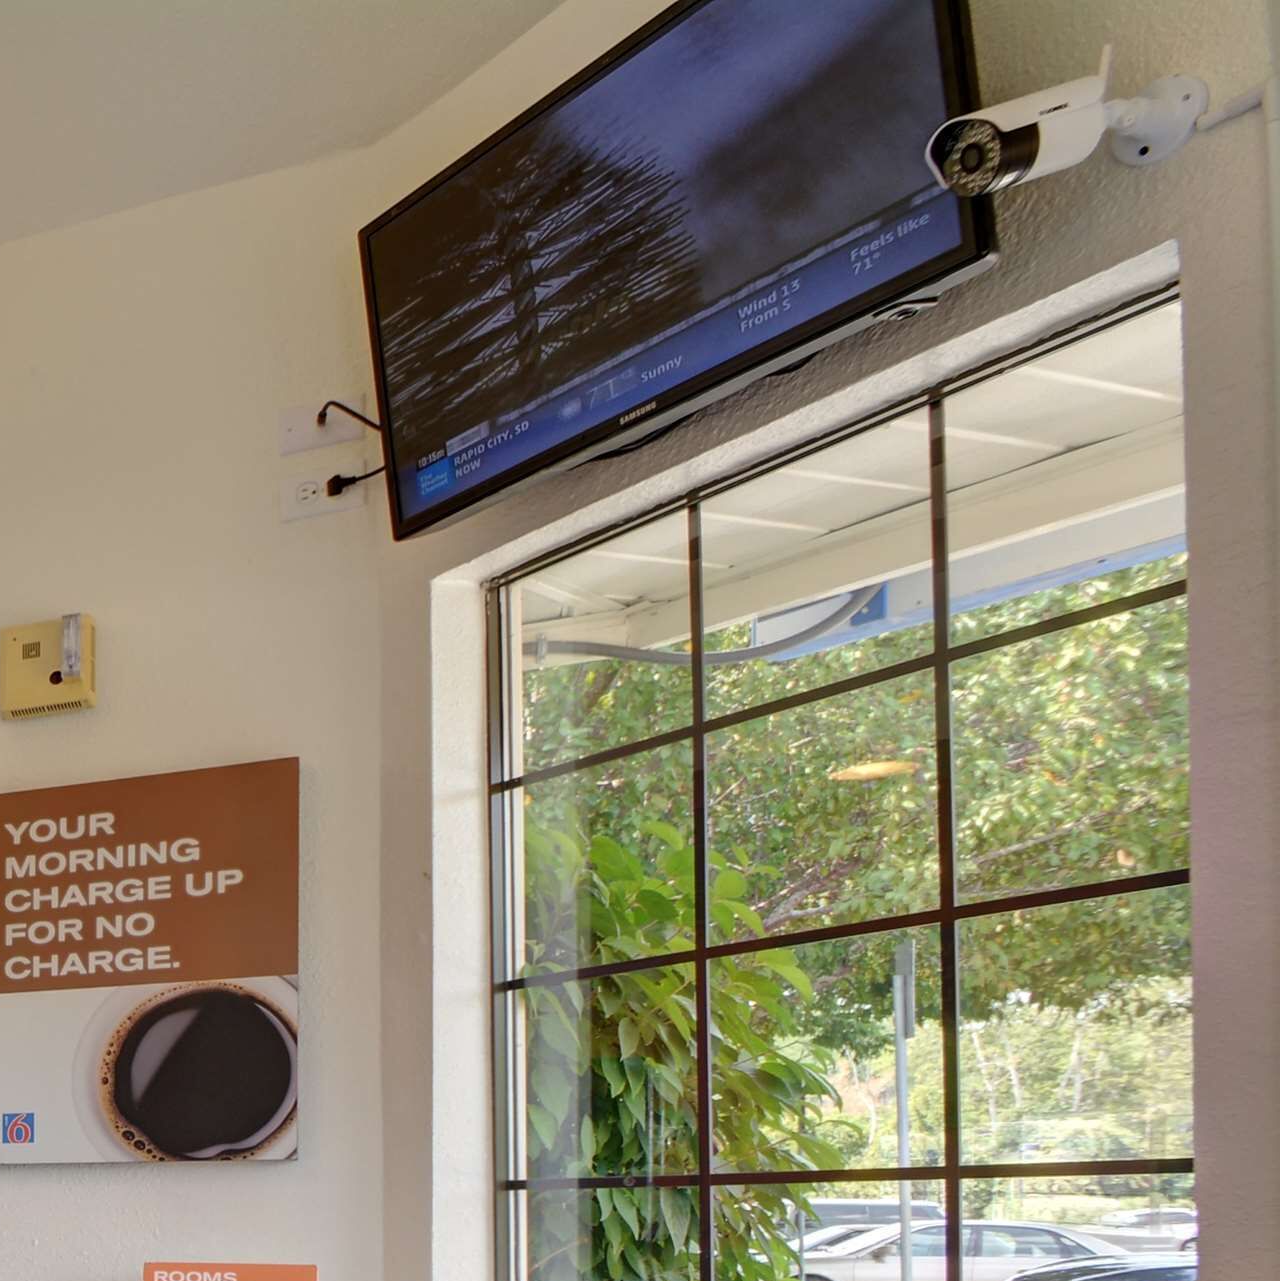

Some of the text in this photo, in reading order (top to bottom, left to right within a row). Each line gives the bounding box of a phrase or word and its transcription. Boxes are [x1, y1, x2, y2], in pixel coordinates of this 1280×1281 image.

[851, 212, 931, 262] Feels like
[737, 278, 801, 320] Wind 13
[740, 299, 792, 333] From S
[641, 356, 682, 383] Sunny
[619, 401, 657, 425] SAMSUNG
[454, 420, 530, 468] RAPID CITY, SD
[455, 458, 481, 479] NOW
[4, 811, 116, 845] YOUR
[5, 838, 200, 880] MORNING
[4, 869, 244, 913] CHARGE UP
[4, 912, 155, 947] FOR NO
[4, 945, 180, 980] CHARGE.
[7, 1112, 31, 1144] 6
